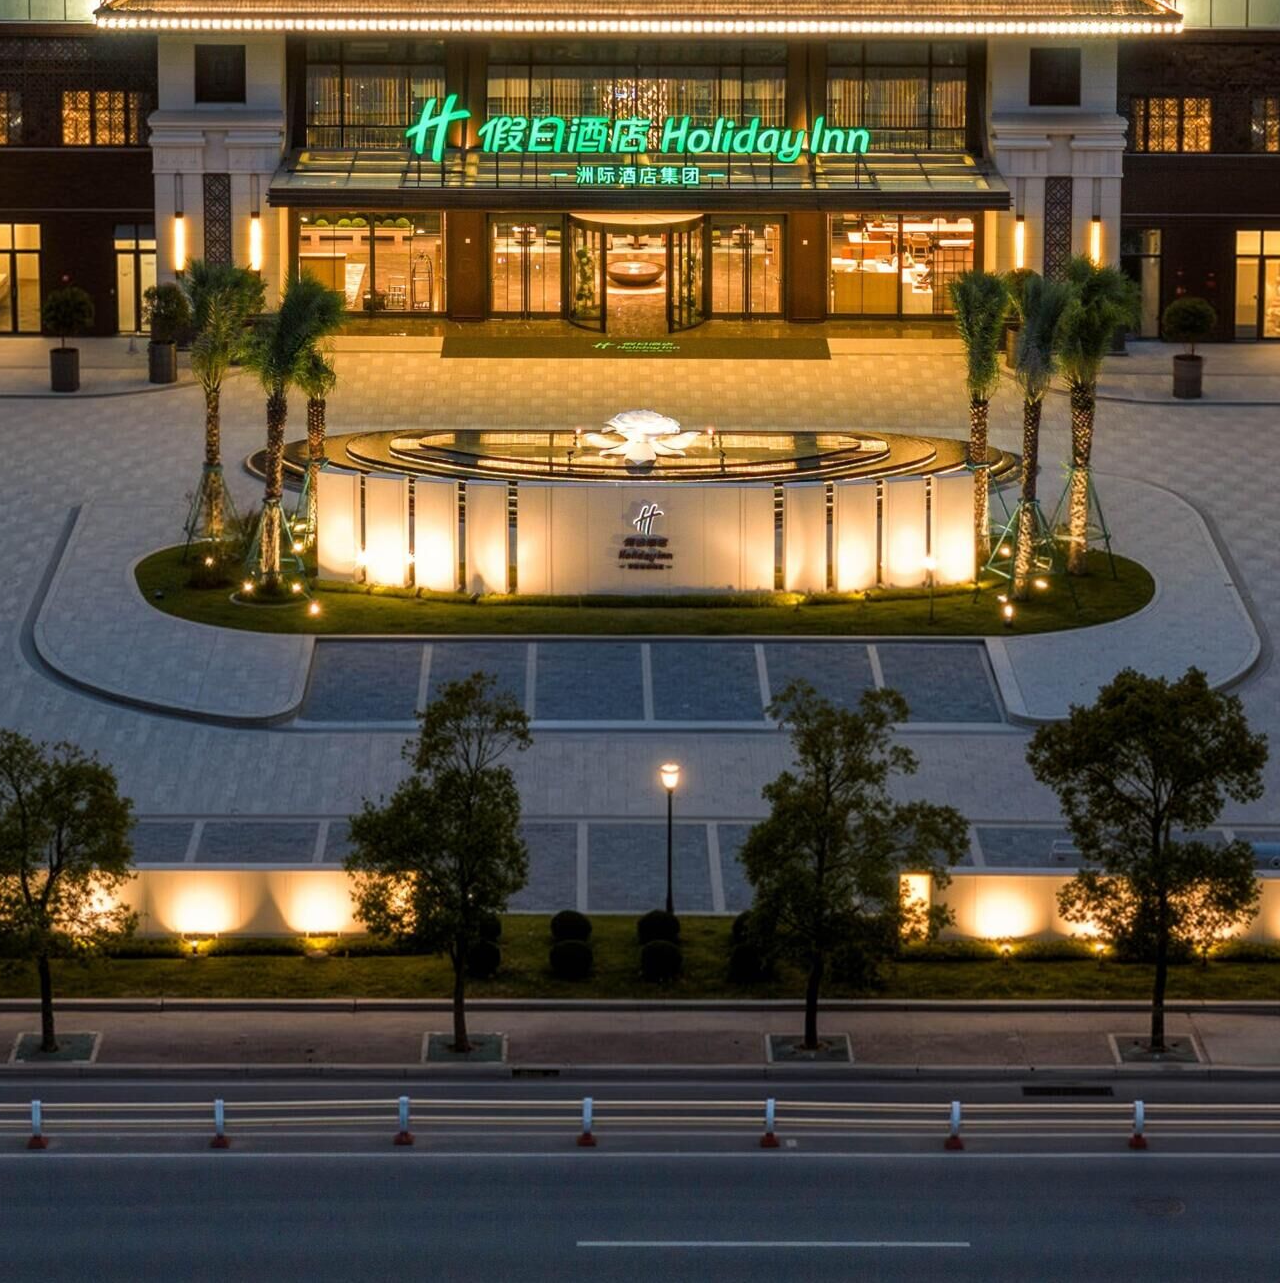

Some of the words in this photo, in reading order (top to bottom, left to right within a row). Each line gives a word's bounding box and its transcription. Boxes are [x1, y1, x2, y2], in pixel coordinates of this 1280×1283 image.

[478, 116, 650, 153] 假日酒店
[661, 116, 805, 163] Holiday
[810, 116, 870, 154] Inn
[576, 166, 700, 185] 洲际酒店集团
